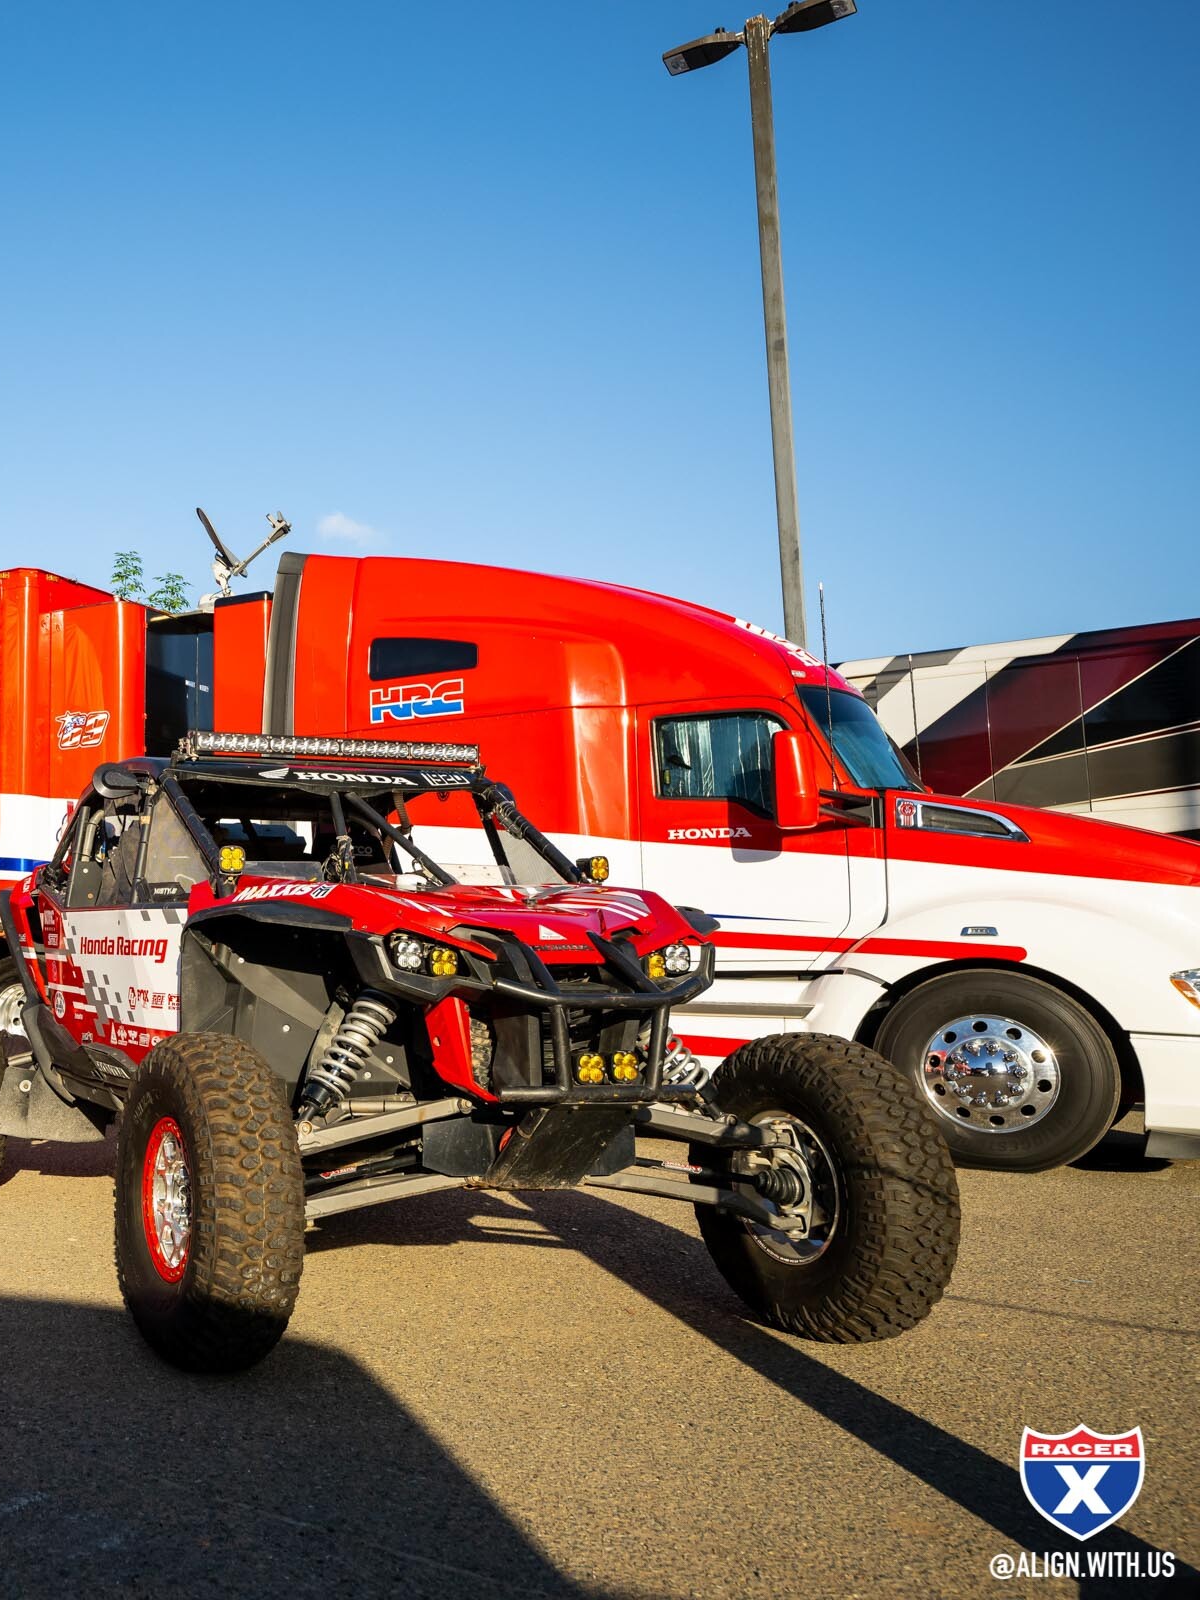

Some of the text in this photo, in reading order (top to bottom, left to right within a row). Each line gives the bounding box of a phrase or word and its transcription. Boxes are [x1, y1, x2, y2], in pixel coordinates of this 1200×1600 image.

[369, 678, 464, 724] HRC
[55, 710, 110, 750] 69
[293, 771, 419, 786] HONDA
[667, 826, 753, 841] HONDA
[232, 884, 318, 903] MAXXIS
[80, 936, 115, 956] Honda
[116, 936, 169, 964] Racing
